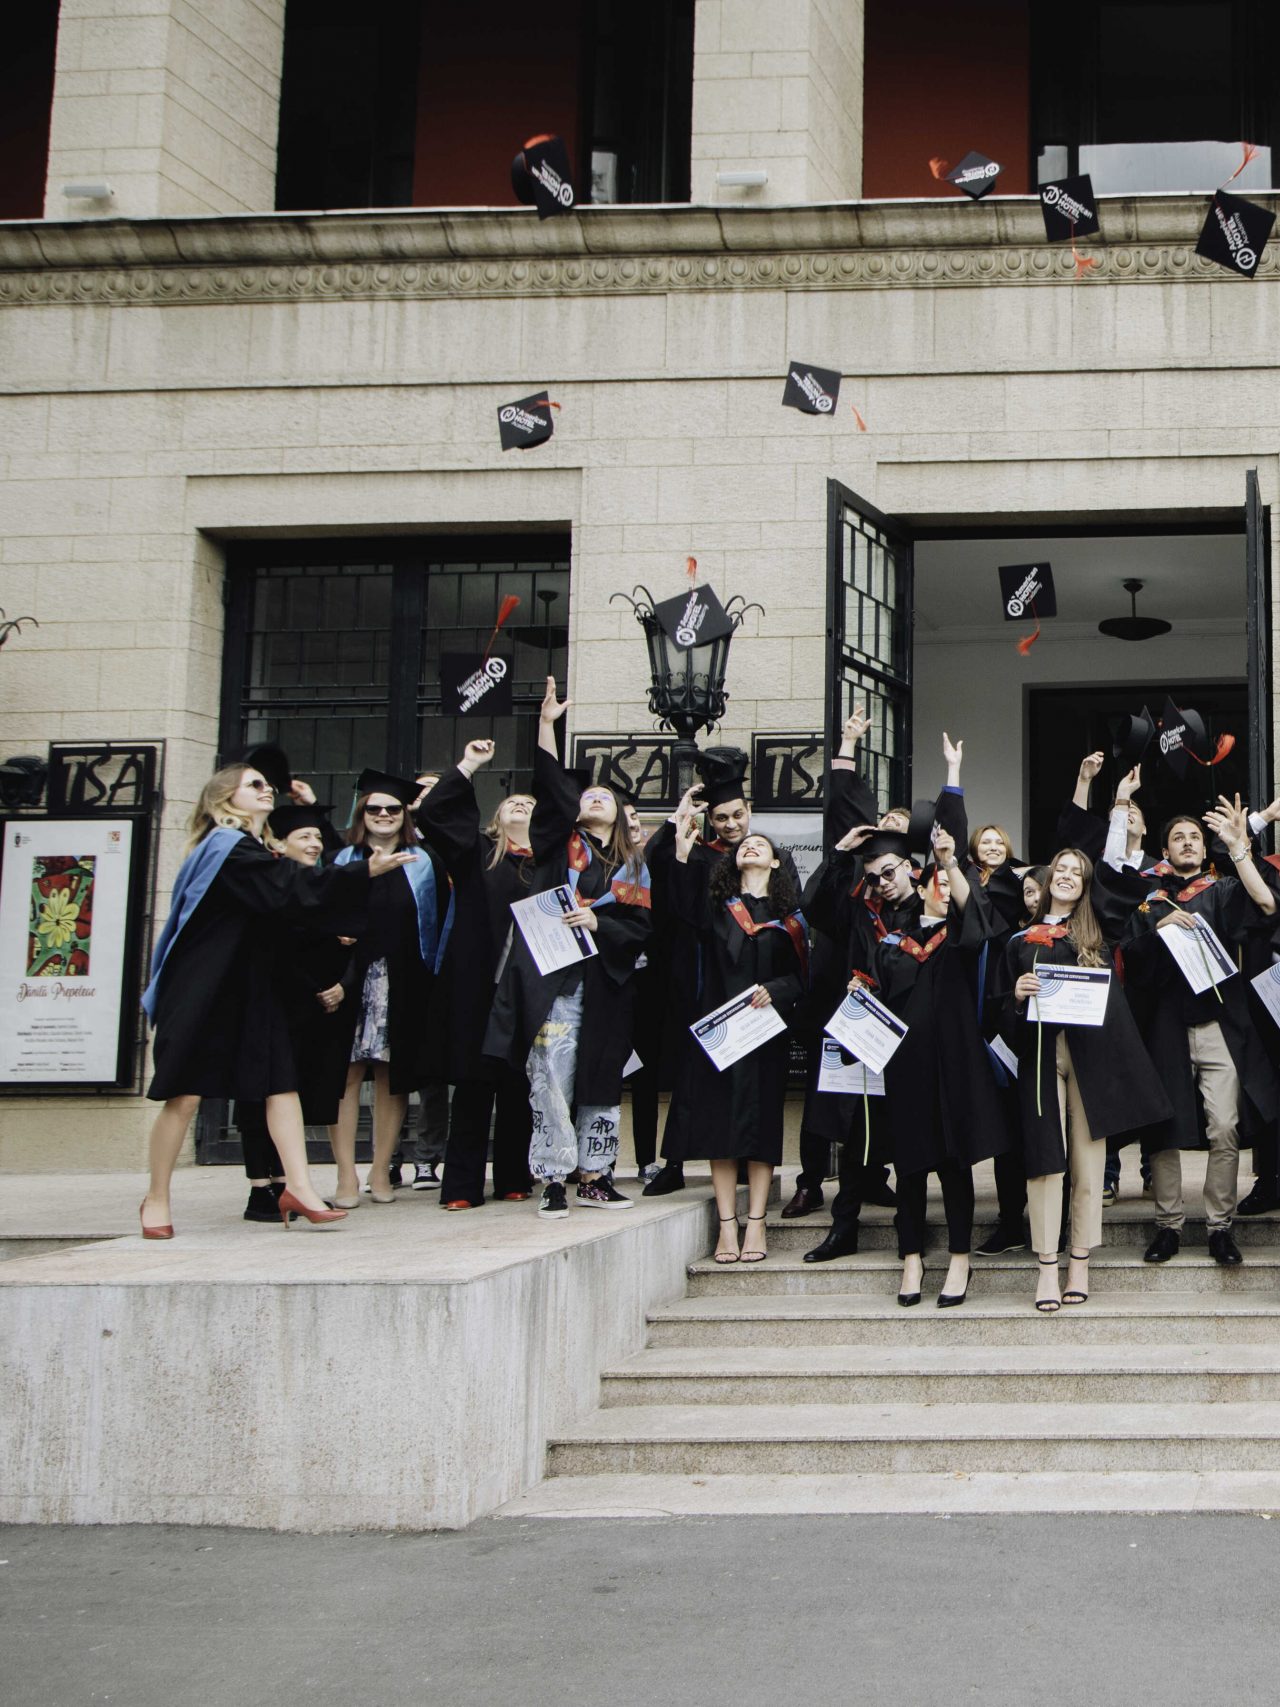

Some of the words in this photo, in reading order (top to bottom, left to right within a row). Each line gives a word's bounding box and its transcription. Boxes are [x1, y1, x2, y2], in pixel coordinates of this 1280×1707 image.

[1058, 199, 1080, 218] HOTEL
[1060, 193, 1093, 219] American
[1215, 207, 1237, 250] American
[1227, 216, 1244, 249] HOTEL
[1015, 567, 1038, 598] American
[1019, 580, 1038, 602] HOTEL
[680, 591, 698, 627] American
[686, 604, 702, 629] HOTEL
[460, 678, 494, 712] American
[463, 672, 490, 696] HOTEL
[1168, 724, 1185, 737] American
[1168, 734, 1182, 745] HOTEL
[62, 753, 146, 806] TSA
[585, 745, 670, 799] TSA
